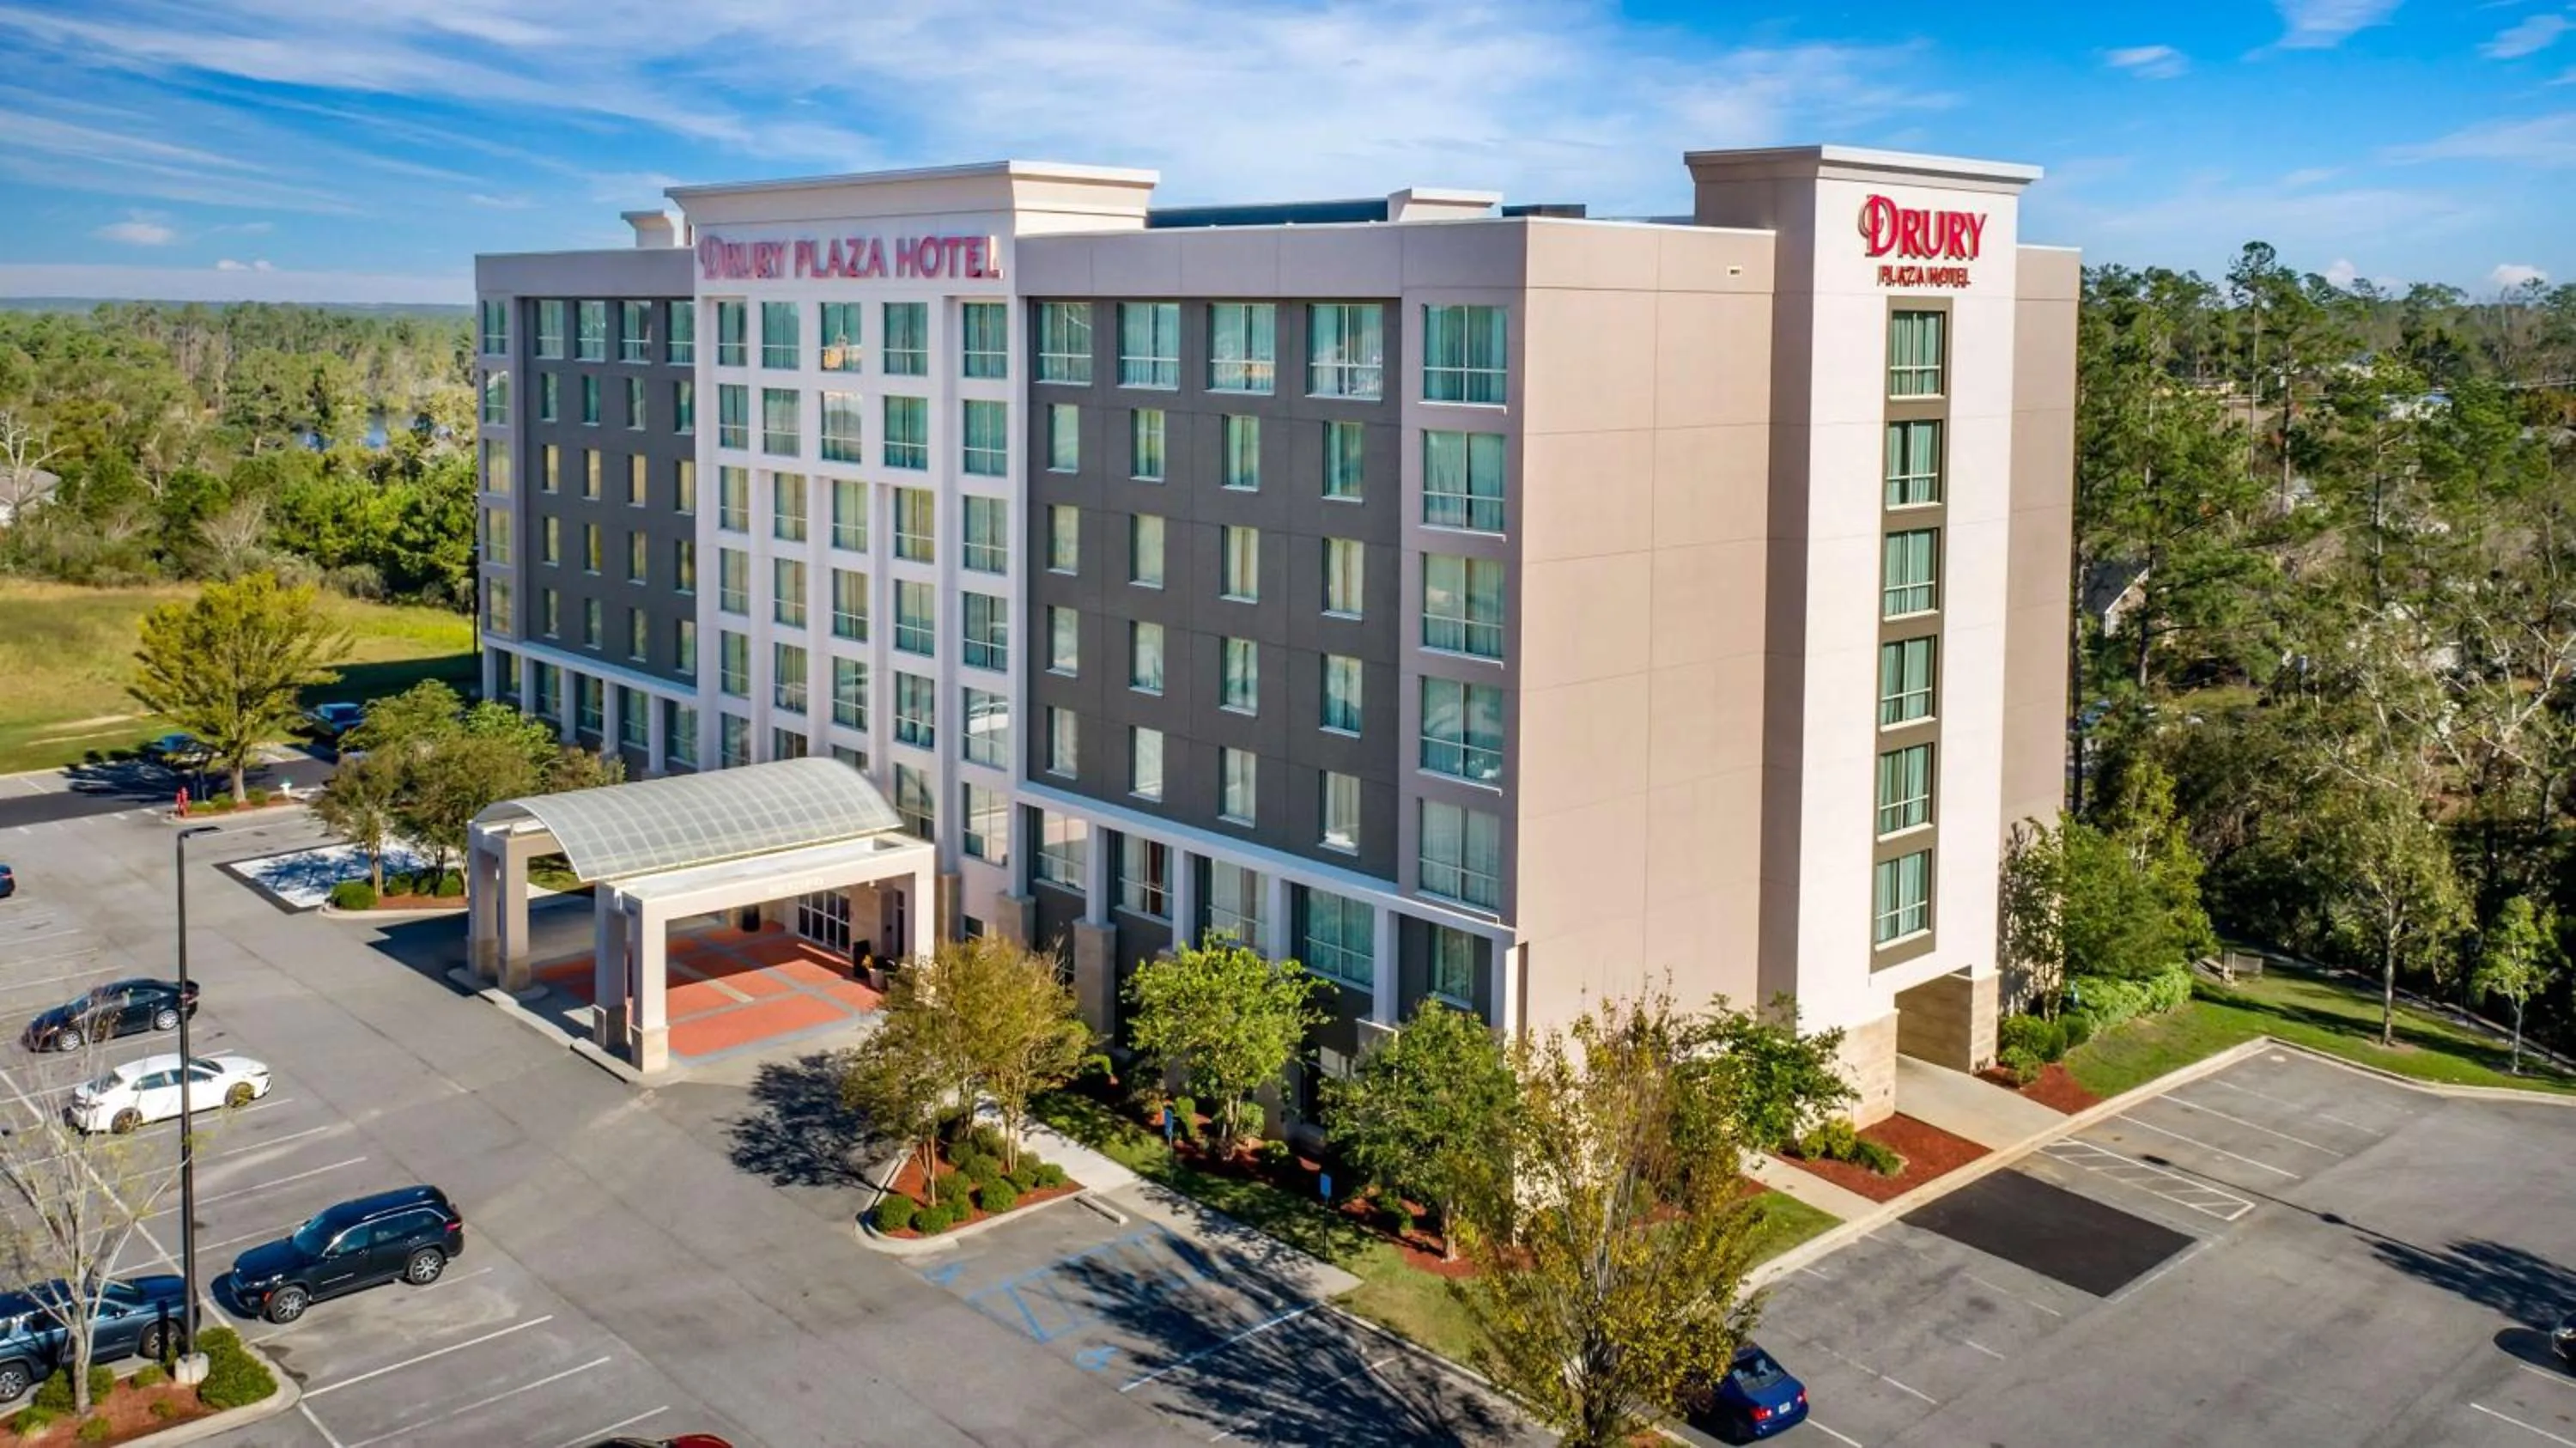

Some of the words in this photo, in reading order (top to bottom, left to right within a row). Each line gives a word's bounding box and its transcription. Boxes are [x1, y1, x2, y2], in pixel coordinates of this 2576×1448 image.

[1857, 194, 1988, 260] DRURY
[698, 234, 788, 279] DRURY
[793, 235, 889, 279] PLAZA
[896, 235, 1004, 279] HOTEL
[1877, 265, 1924, 287] PLAZA
[1926, 267, 1971, 288] HOTEL
